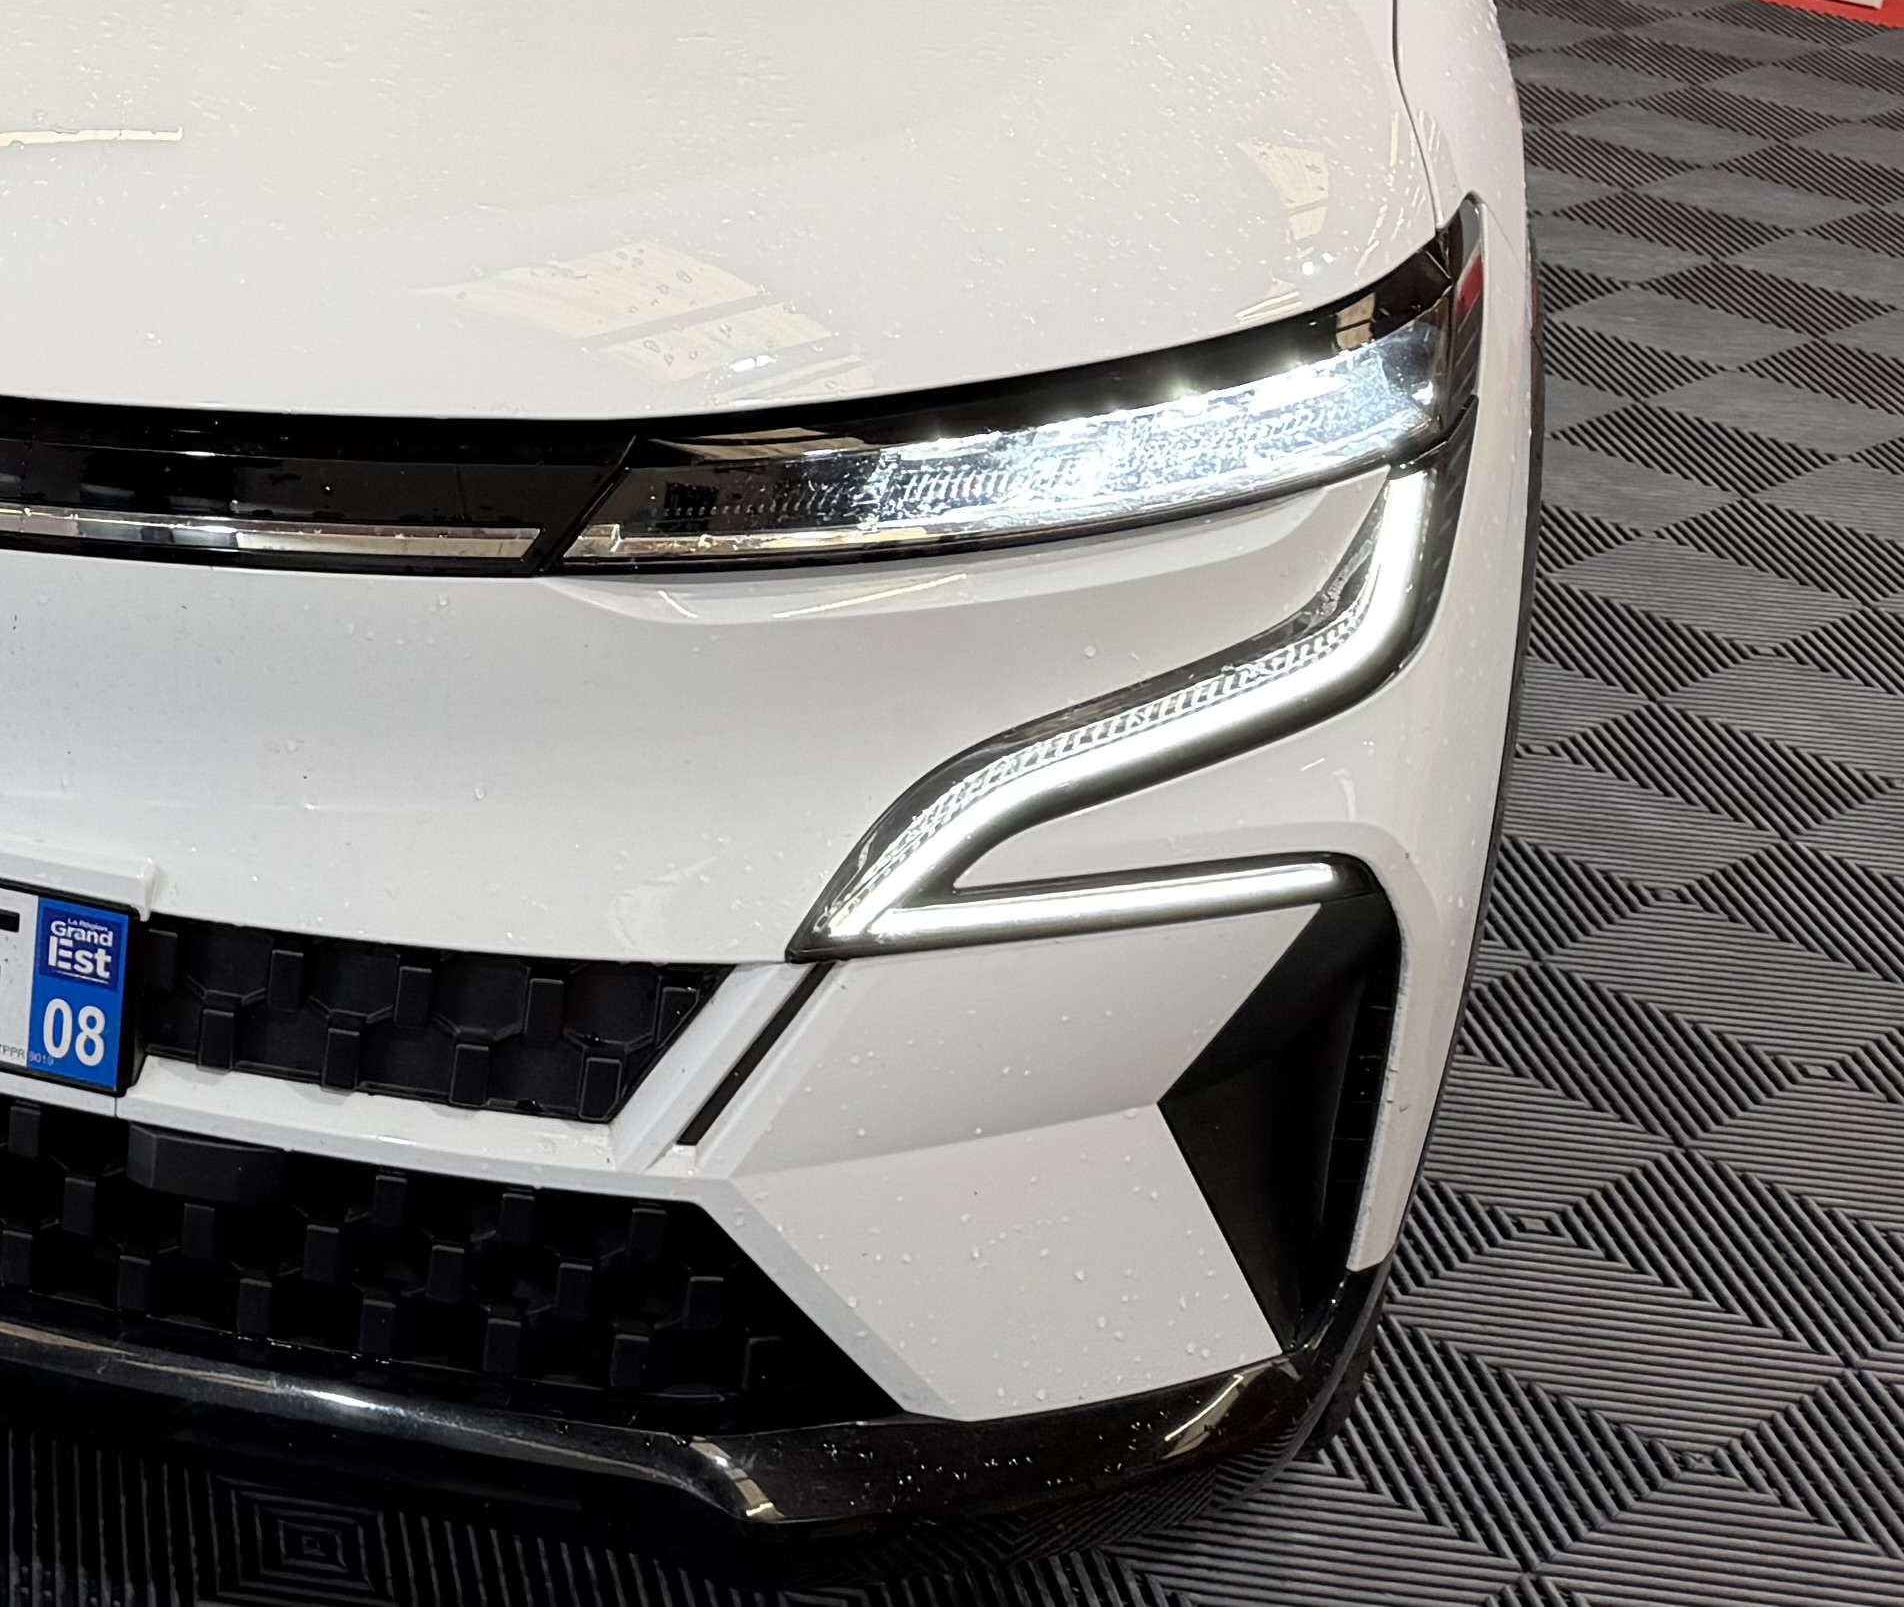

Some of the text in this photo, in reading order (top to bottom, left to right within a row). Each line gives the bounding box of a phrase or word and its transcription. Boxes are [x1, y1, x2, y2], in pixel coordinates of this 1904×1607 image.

[50, 920, 114, 947] Grand
[48, 935, 112, 978] Est
[43, 998, 106, 1067] 08
